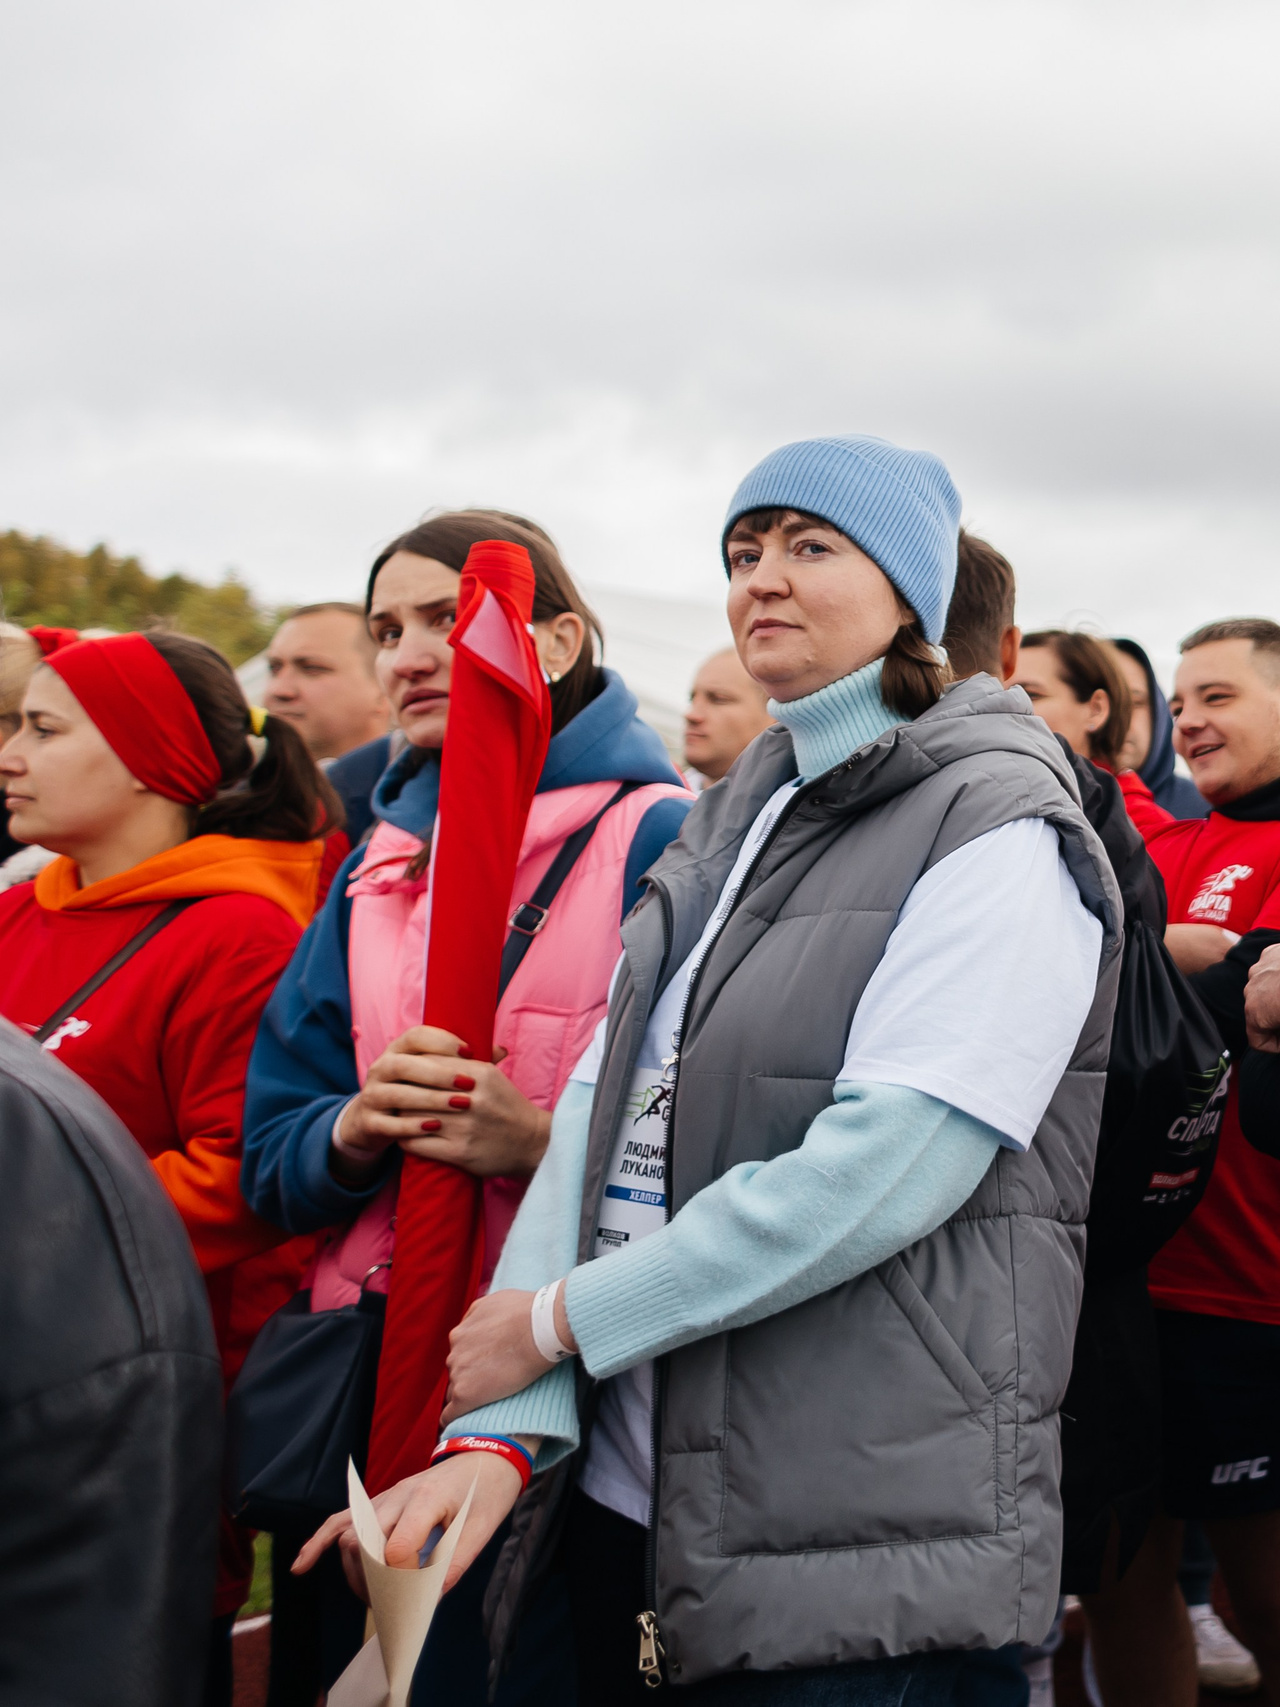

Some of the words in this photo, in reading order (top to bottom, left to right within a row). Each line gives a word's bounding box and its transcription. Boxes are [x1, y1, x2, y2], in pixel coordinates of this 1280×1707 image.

[1167, 1110, 1221, 1142] СПАРТА
[628, 1189, 663, 1205] ХЕЛПЕР
[1211, 1456, 1270, 1484] UFC
